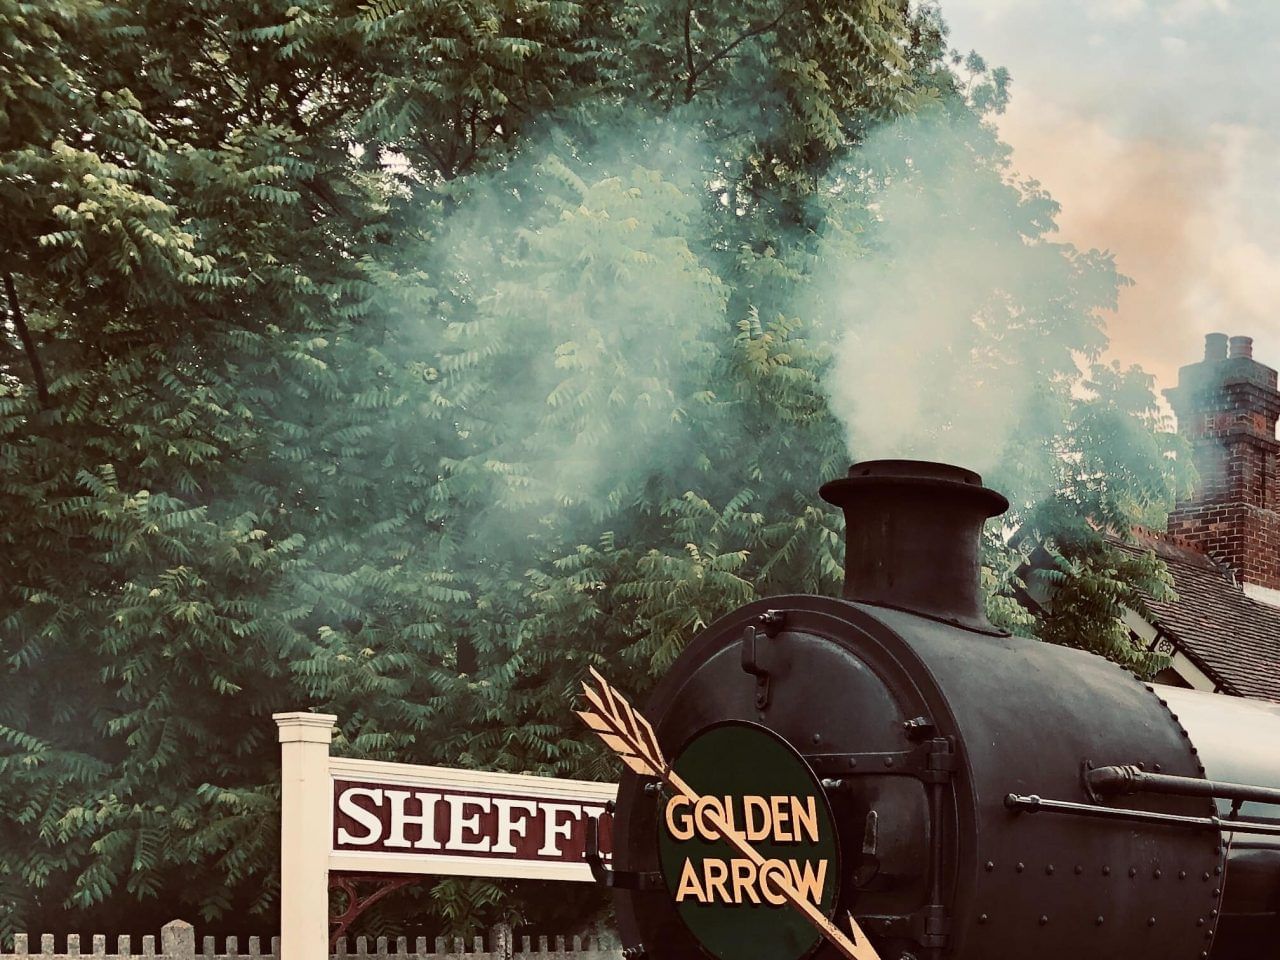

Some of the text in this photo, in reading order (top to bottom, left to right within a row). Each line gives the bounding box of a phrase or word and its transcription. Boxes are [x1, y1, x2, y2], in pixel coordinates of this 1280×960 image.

[337, 787, 615, 859] SHEFF
[665, 794, 819, 842] GOLDEN
[675, 856, 828, 905] ARROW
